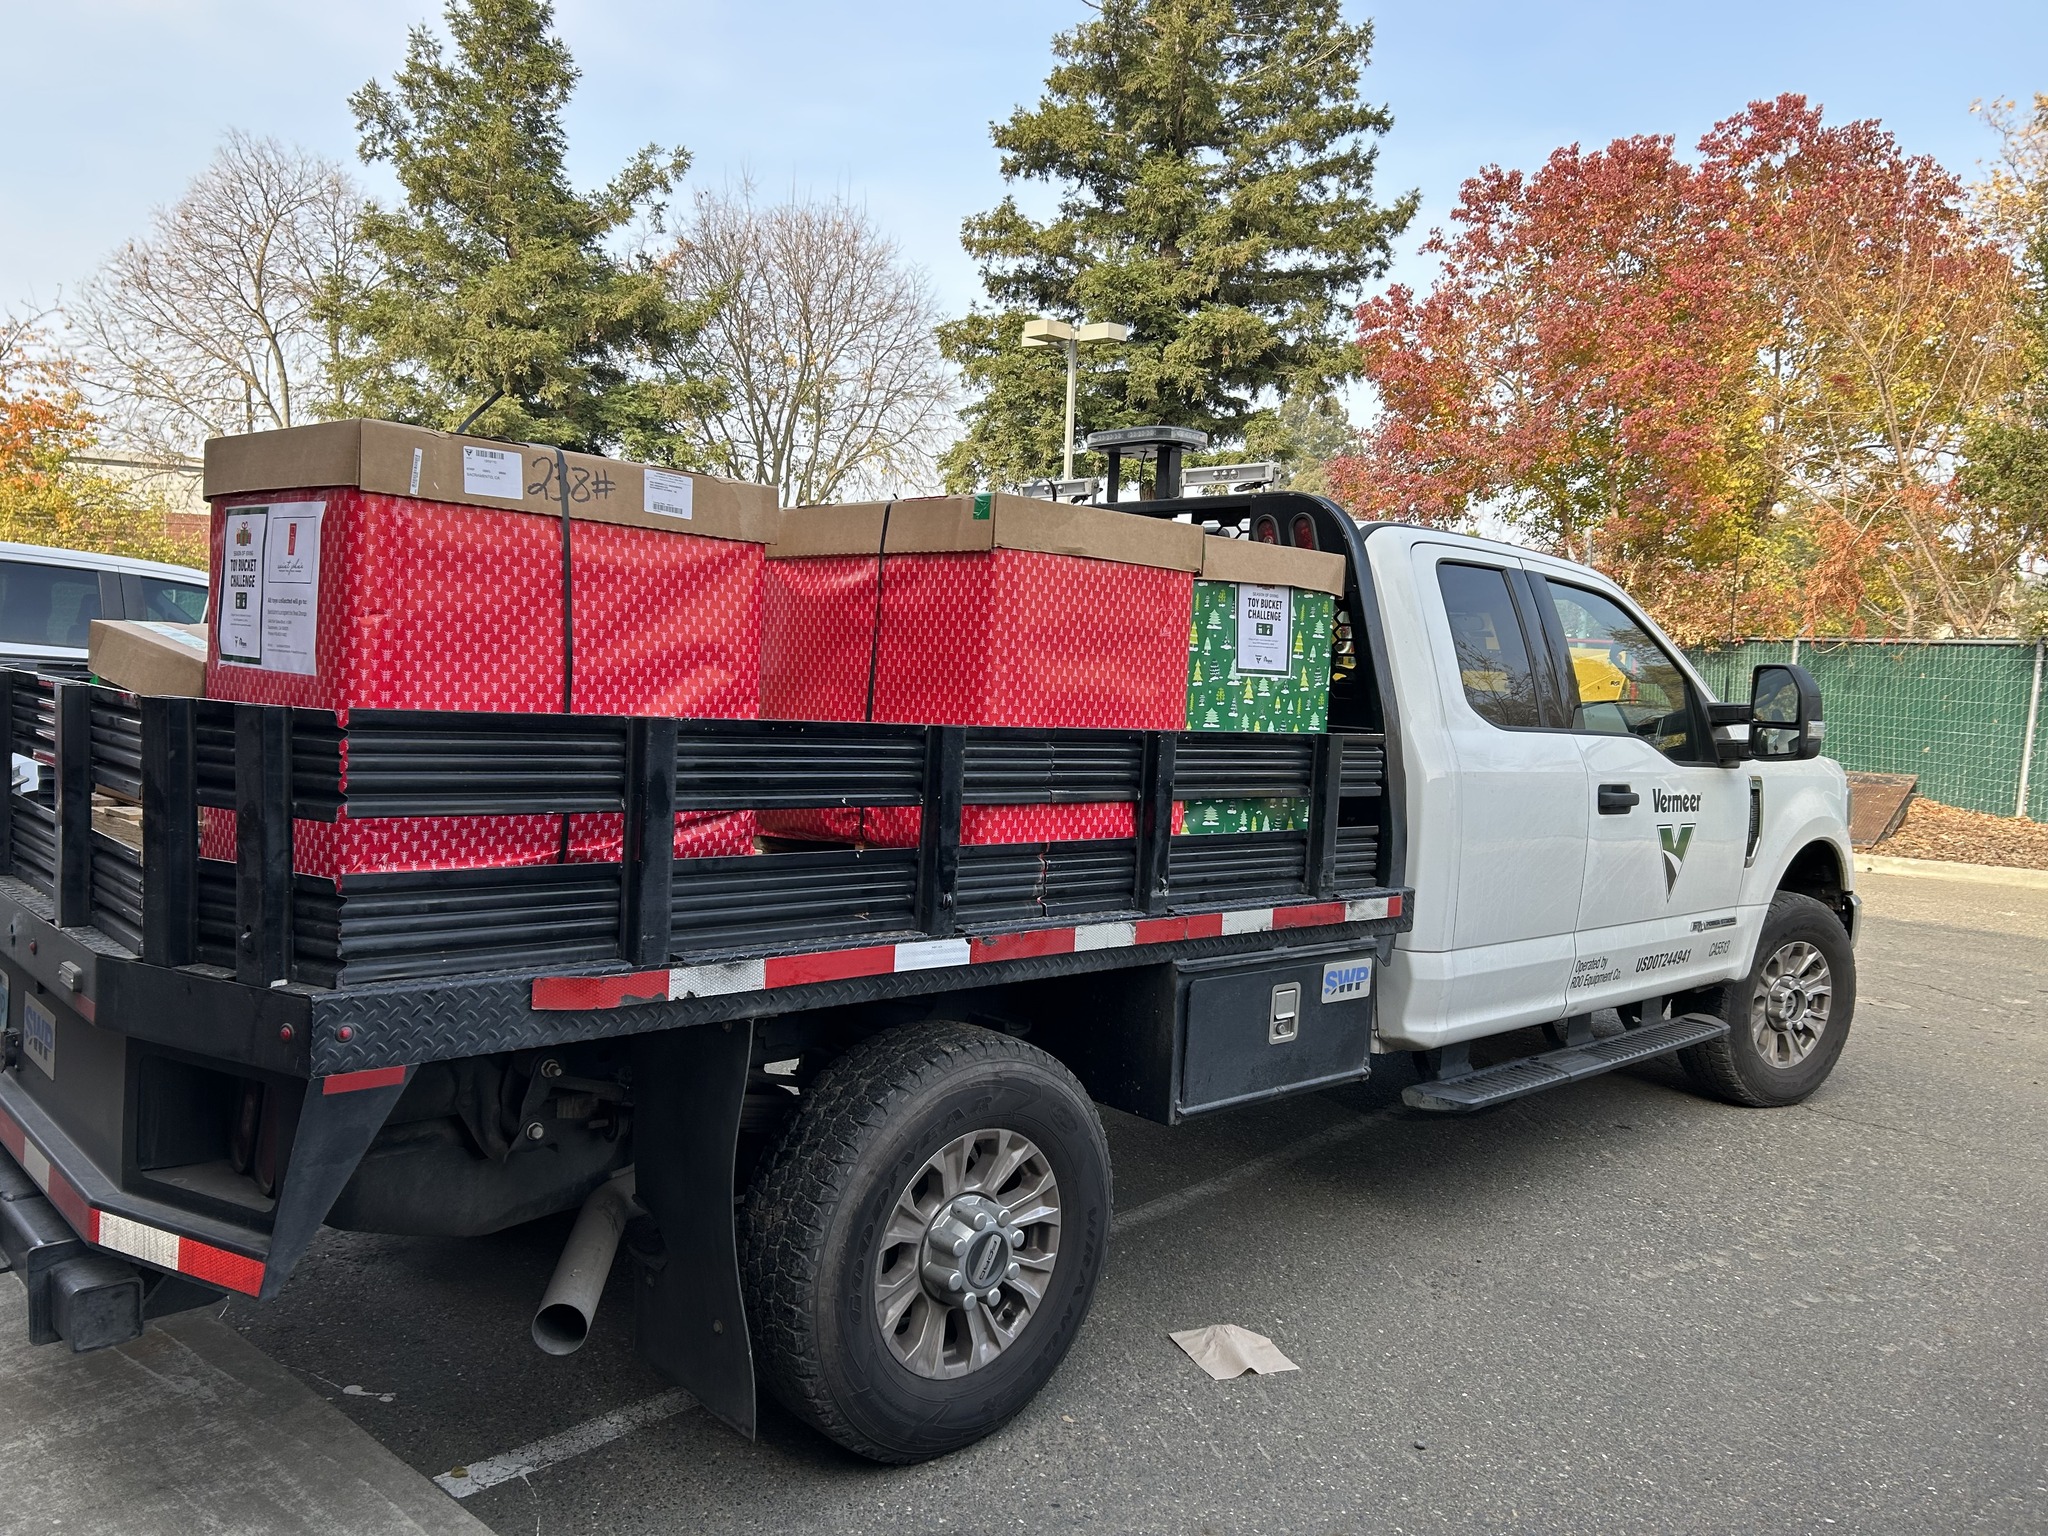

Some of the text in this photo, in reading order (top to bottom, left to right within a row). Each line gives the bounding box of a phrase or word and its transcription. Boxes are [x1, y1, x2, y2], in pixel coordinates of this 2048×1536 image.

[230, 559, 257, 572] TOY BUCKET
[230, 575, 256, 588] CHALLENGE
[1247, 597, 1283, 610] TOY BUCKET
[1247, 609, 1282, 621] CHALLENGE
[1652, 788, 1702, 813] Vermeer
[1708, 940, 1731, 957] CA5513
[1575, 956, 1609, 974] Operated by
[1635, 949, 1692, 973] USDOT244941
[1324, 966, 1369, 996] SWP
[1570, 968, 1621, 989] RDO Equipment Co.
[24, 1004, 54, 1061] SWP
[850, 1095, 993, 1326] GOODYEAR
[979, 1240, 998, 1280] FORD
